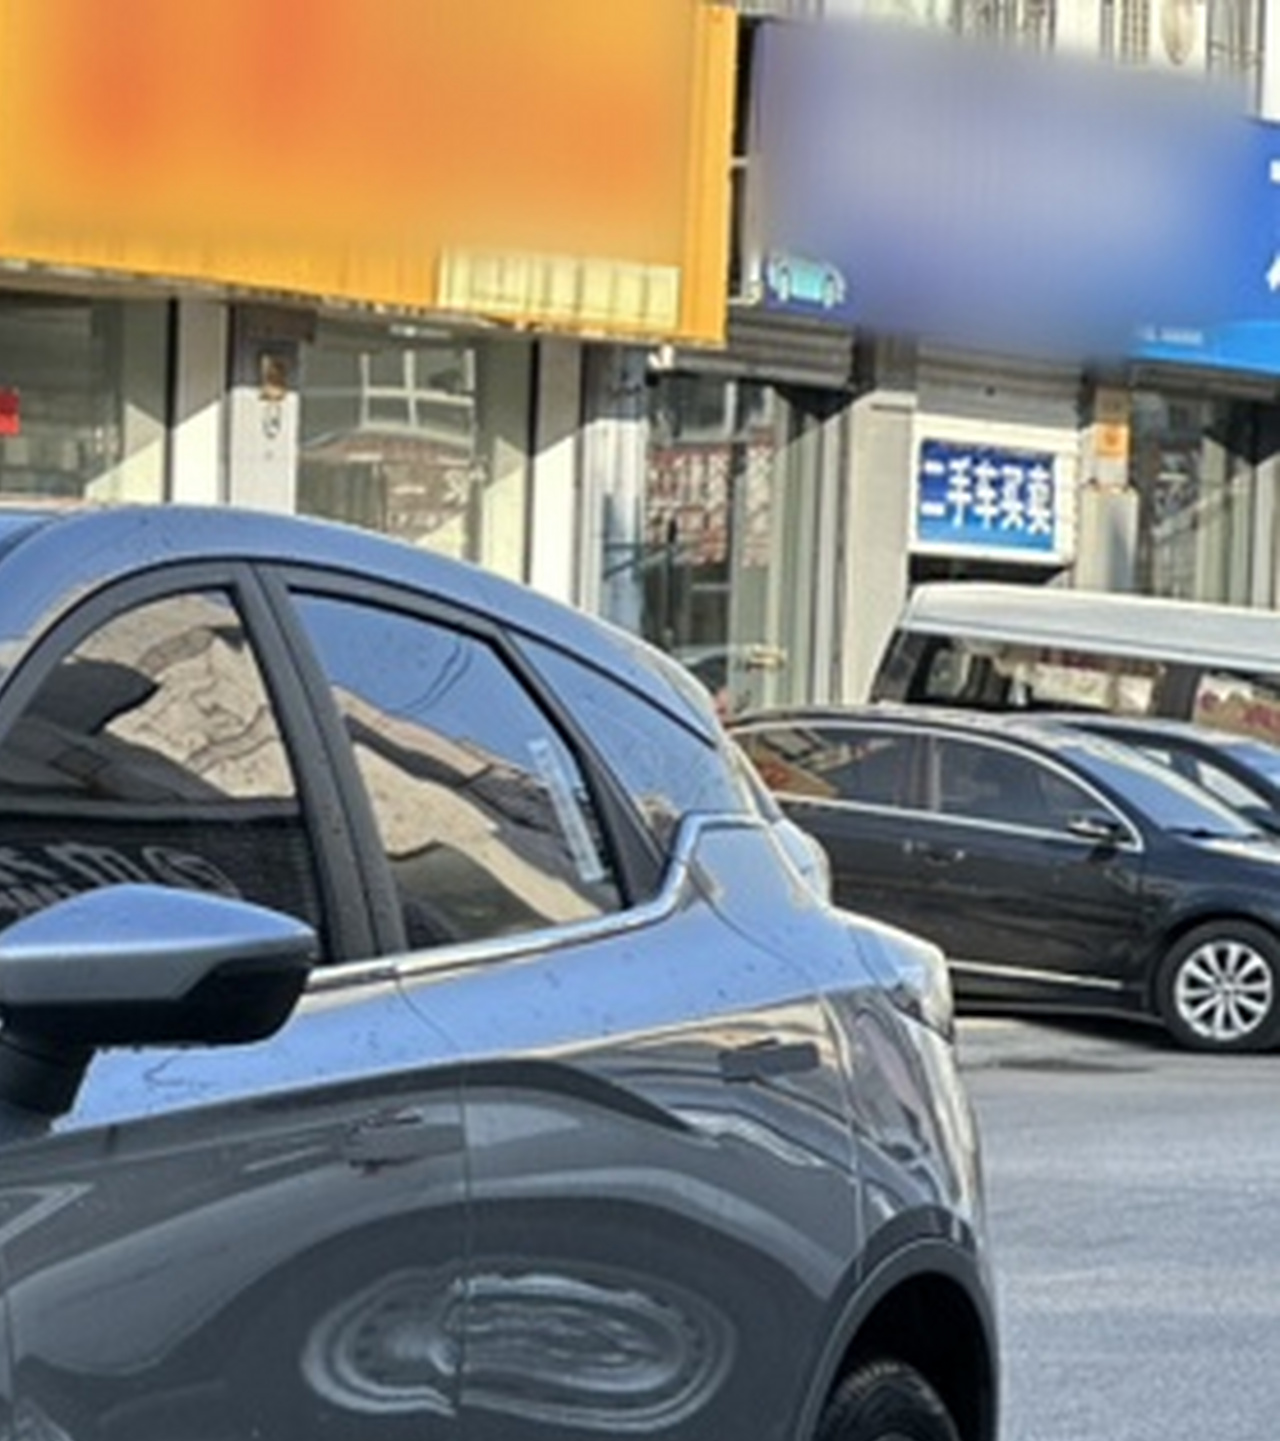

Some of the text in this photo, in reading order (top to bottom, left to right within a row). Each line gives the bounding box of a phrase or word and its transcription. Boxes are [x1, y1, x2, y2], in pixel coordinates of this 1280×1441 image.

[920, 455, 1052, 535] 二手车买卖
